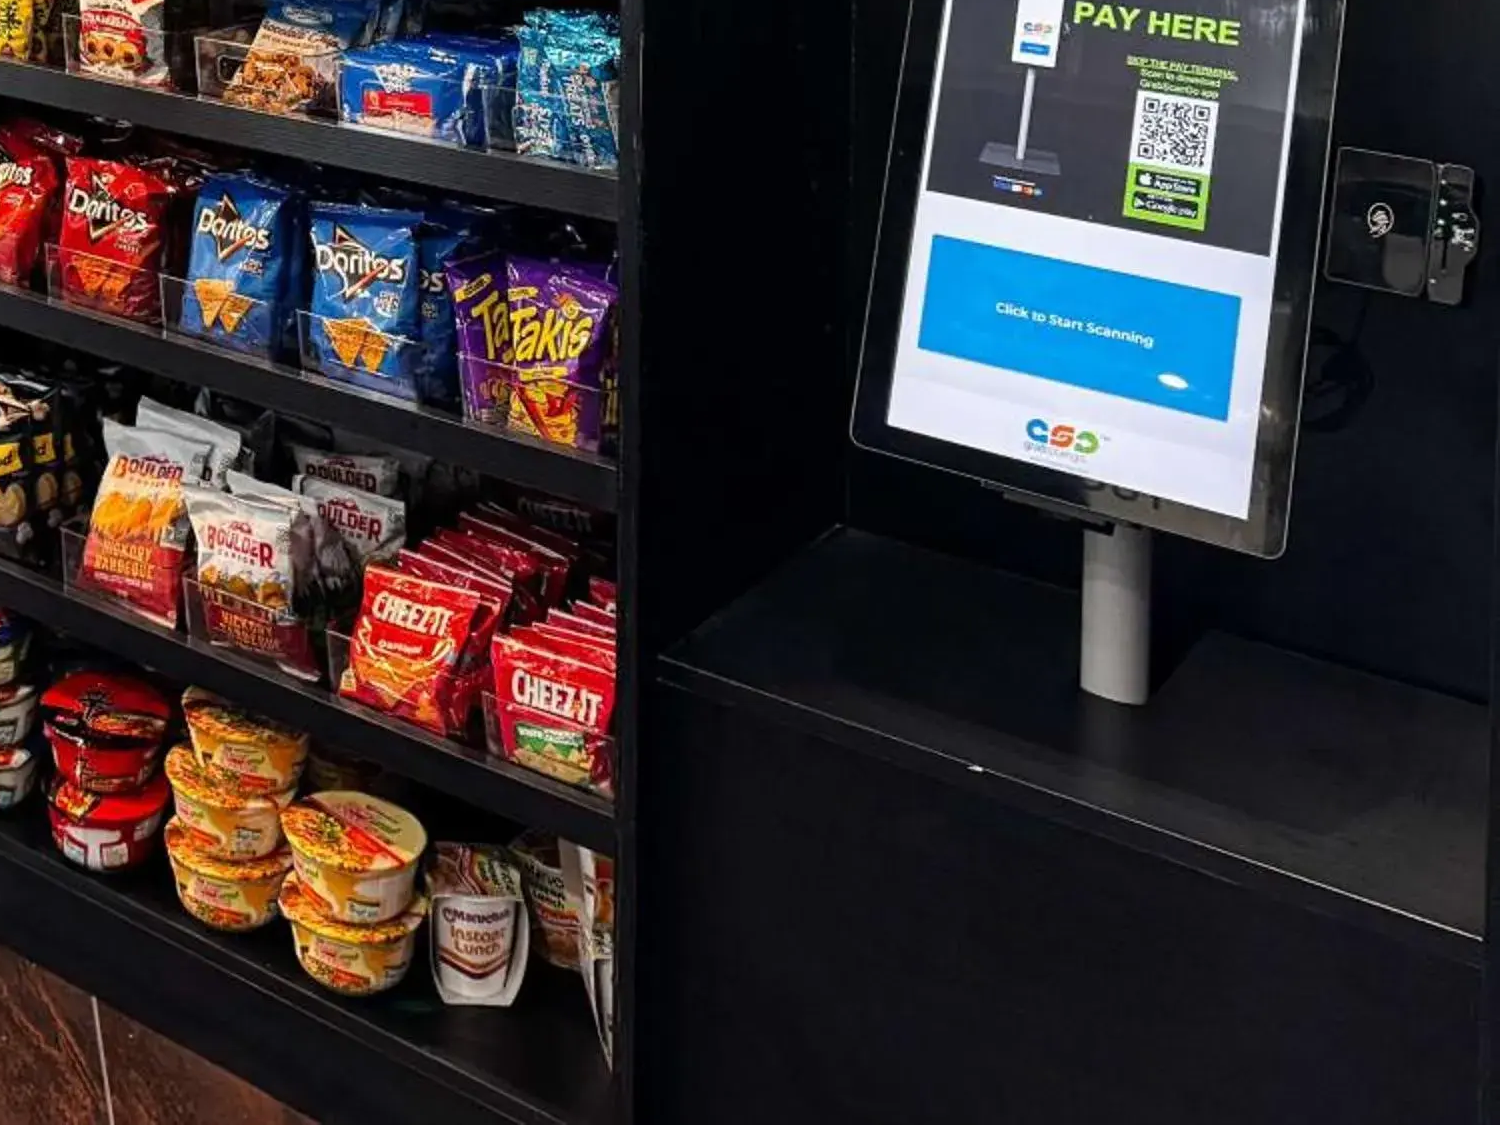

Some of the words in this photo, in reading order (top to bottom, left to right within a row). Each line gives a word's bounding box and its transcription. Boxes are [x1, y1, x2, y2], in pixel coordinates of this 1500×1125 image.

[1073, 0, 1141, 32] PAY
[1147, 11, 1242, 47] HERE
[1153, 179, 1172, 192] App
[69, 189, 148, 233] Doritos
[199, 209, 271, 251] Doritos
[316, 245, 406, 280] Doritos
[510, 306, 594, 362] Takis
[995, 301, 1029, 320] Click
[1031, 311, 1046, 323] to
[1048, 314, 1084, 332] Start
[1086, 322, 1155, 350] Scanning
[112, 455, 185, 482] BOULDER
[207, 523, 275, 568] BOULDER
[512, 668, 603, 727] CHEEZ-IT
[454, 939, 501, 956] Lunch
